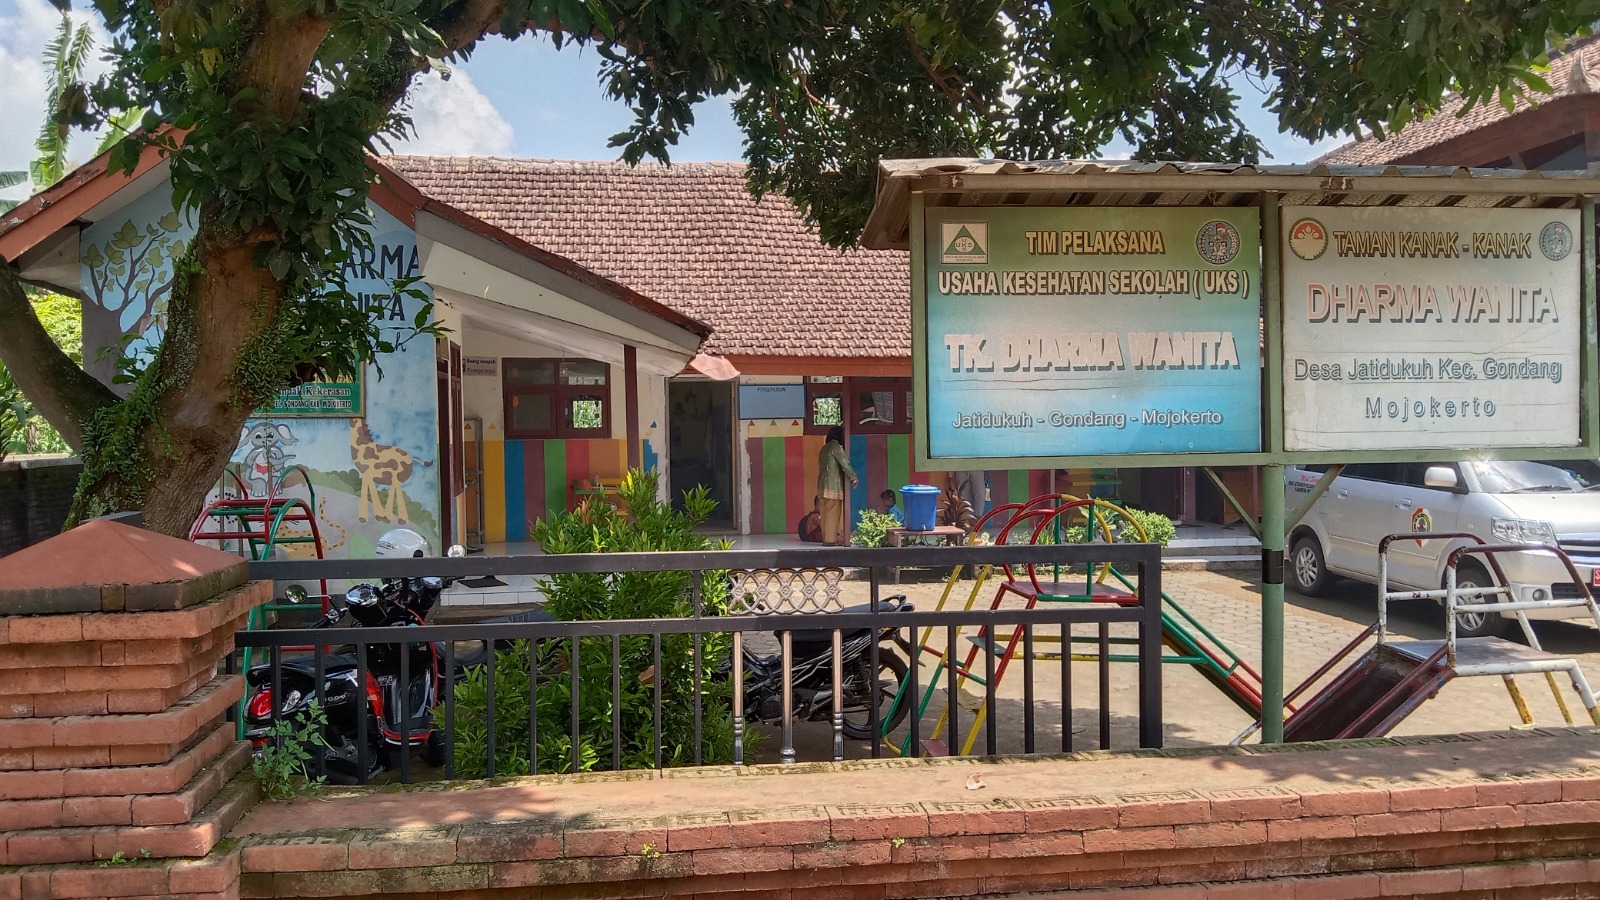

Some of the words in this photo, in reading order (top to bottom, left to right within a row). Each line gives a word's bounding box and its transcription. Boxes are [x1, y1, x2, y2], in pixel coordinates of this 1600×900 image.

[1026, 231, 1060, 254] TIM
[1062, 230, 1165, 254] PELAKSANA
[1333, 231, 1395, 258] TAMAN
[1399, 231, 1459, 259] KANAK
[1473, 232, 1532, 259] KANAK
[340, 245, 419, 279] ARMA
[938, 271, 999, 295] USAHA
[1002, 270, 1105, 294] KESEHATAN
[1108, 270, 1189, 293] SEKOLAH
[1307, 283, 1442, 323] DHARMA
[1446, 285, 1559, 323] WANITA
[1002, 333, 1125, 372] DHARMA
[1128, 332, 1241, 371] WANITA
[1295, 358, 1342, 382] Desa
[1348, 358, 1433, 381] Jatidukuh
[1438, 357, 1478, 380] Kec.
[1482, 357, 1563, 384] Gondang
[285, 399, 308, 408] GONDANG
[305, 385, 351, 396] Kekerasan
[952, 411, 1033, 430] Jatidukuh
[1048, 411, 1126, 430] Gondang
[1142, 409, 1223, 429] Mojokerto
[1365, 396, 1496, 423] Mojokerto
